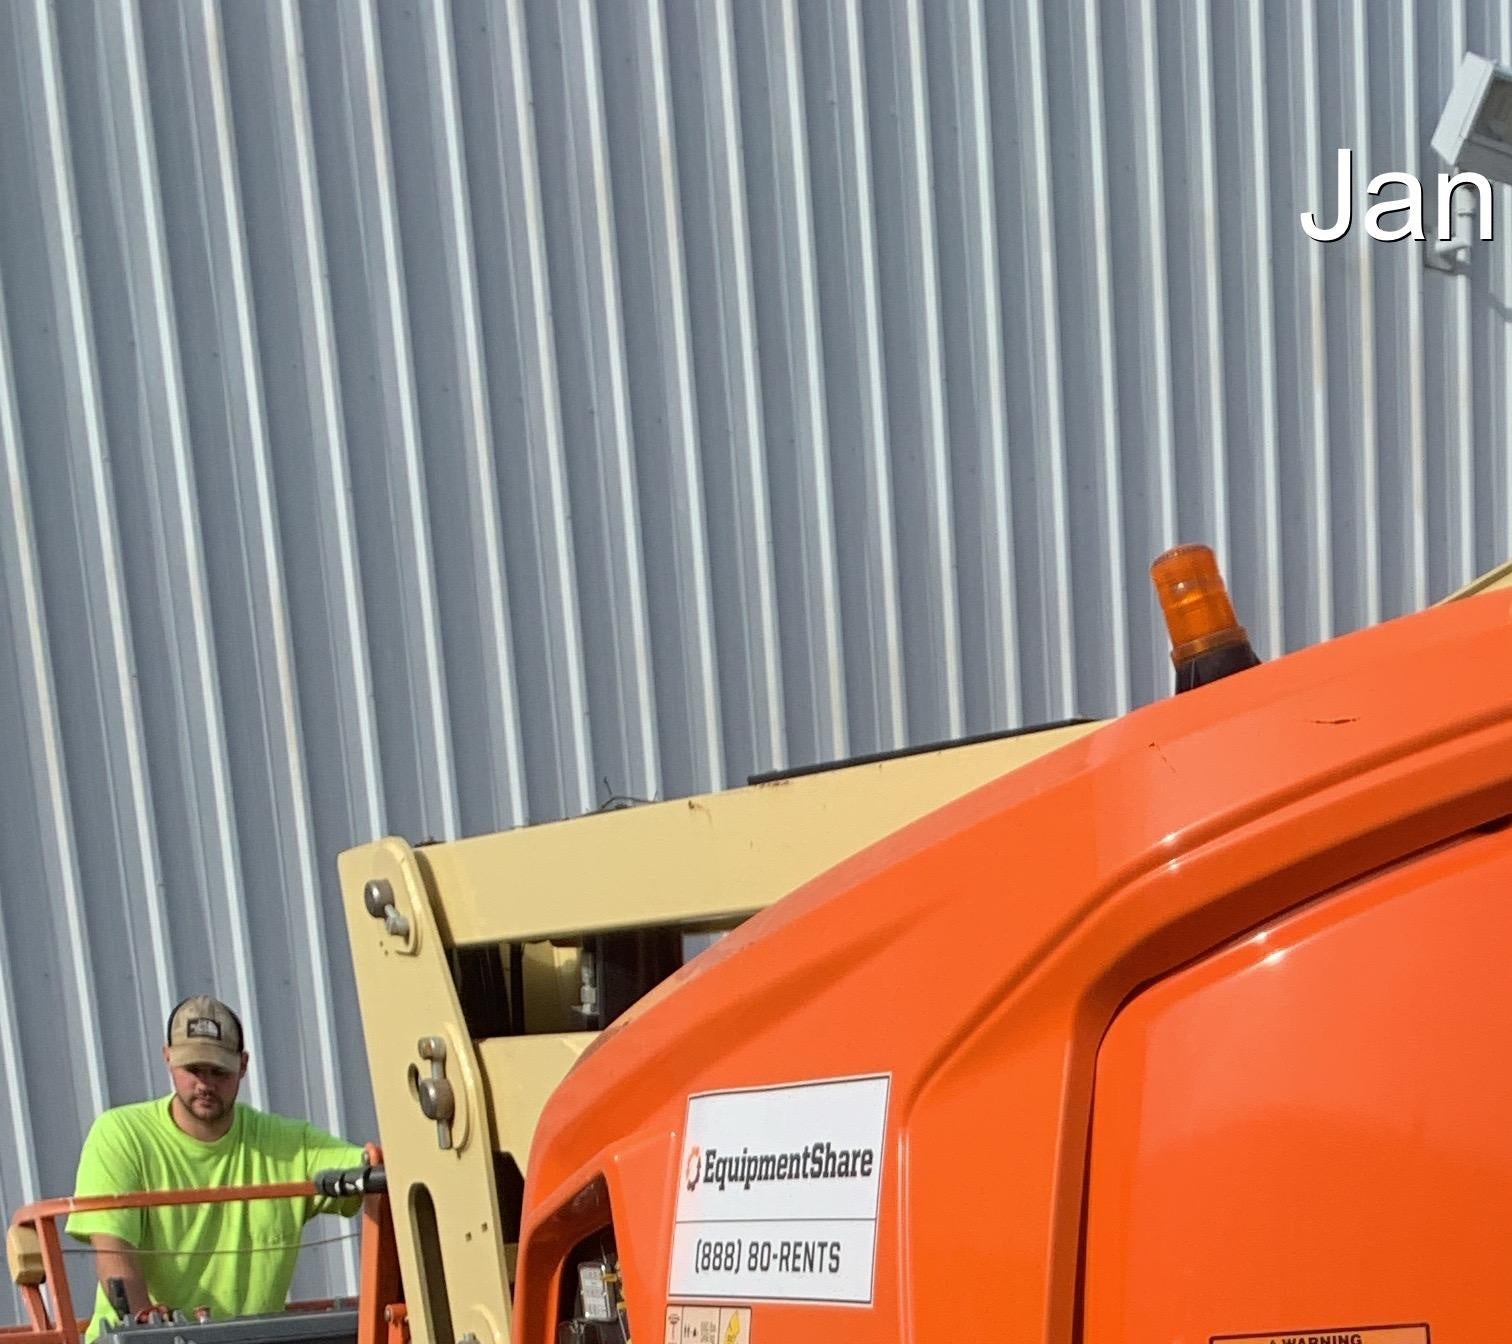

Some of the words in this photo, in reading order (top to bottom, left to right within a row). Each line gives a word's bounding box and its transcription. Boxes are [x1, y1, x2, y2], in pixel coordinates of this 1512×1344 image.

[702, 1142, 873, 1191] EquipmentShare
[695, 1238, 742, 1274] (888)
[747, 1240, 841, 1273] 80-RENTS
